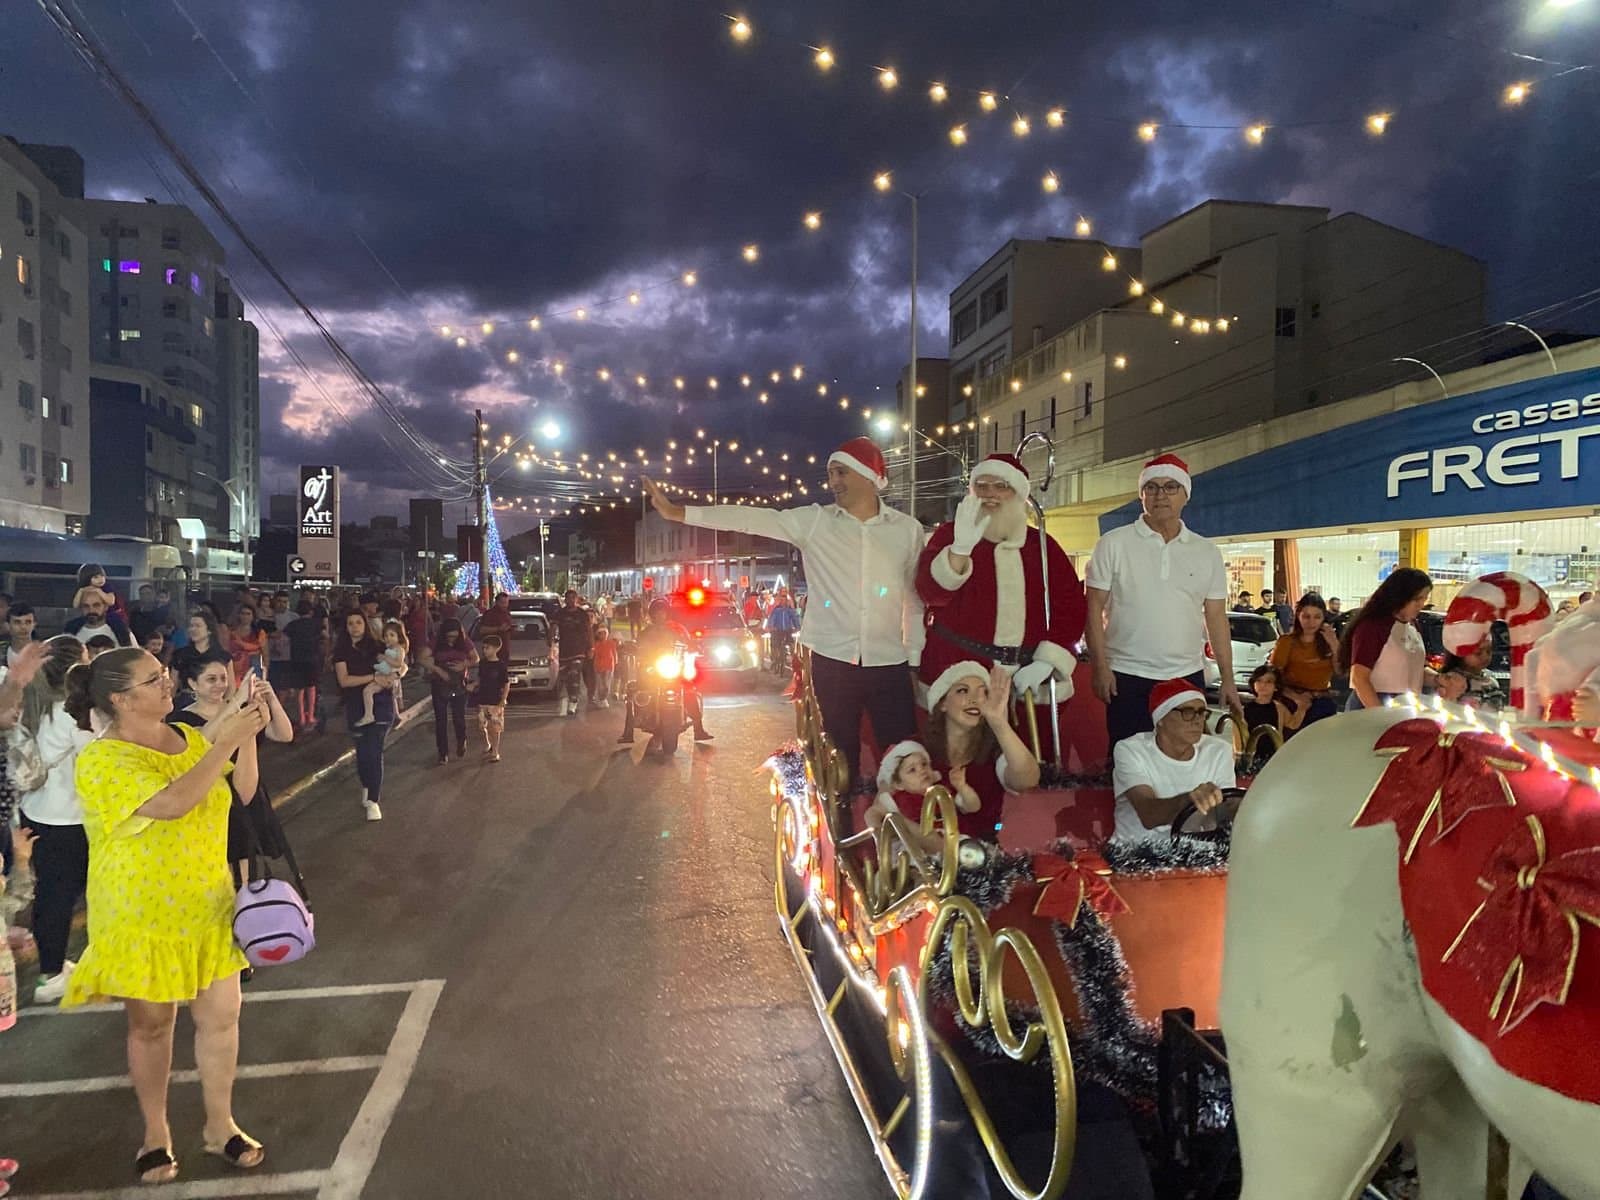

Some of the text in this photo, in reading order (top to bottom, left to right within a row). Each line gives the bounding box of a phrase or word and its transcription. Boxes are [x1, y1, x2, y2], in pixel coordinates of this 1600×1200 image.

[1472, 392, 1600, 434] casas
[302, 506, 332, 523] Art
[302, 526, 333, 535] HOTEL
